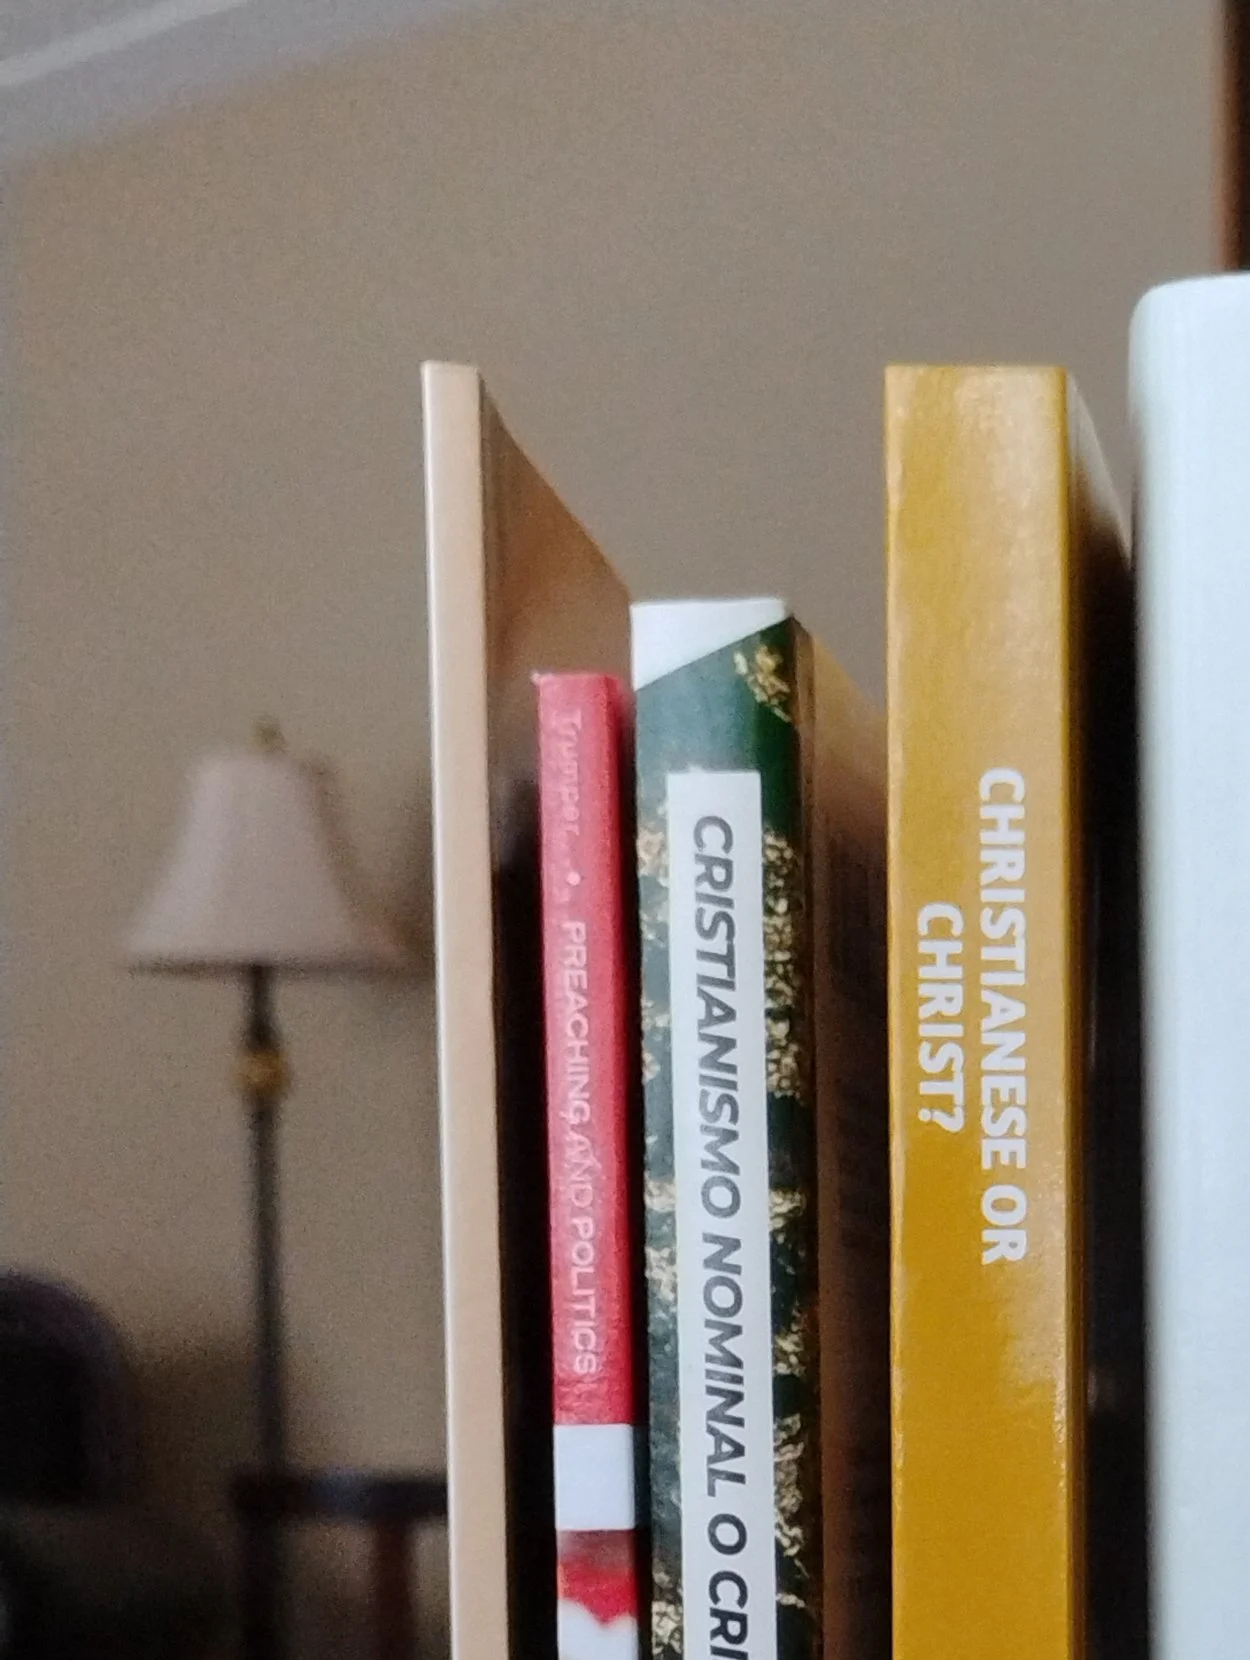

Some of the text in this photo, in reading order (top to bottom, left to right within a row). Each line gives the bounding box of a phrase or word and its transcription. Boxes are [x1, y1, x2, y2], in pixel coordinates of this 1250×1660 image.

[561, 920, 592, 1123] PREACHING
[693, 815, 741, 1219] CRISTIANISMO
[917, 902, 966, 1135] CHRIST?
[978, 766, 1028, 1265] CHRISTIANESE OR
[564, 1132, 596, 1210] AND
[570, 1216, 599, 1375] POLITICS
[701, 1230, 747, 1498] NOMINAL
[707, 1513, 748, 1556] O
